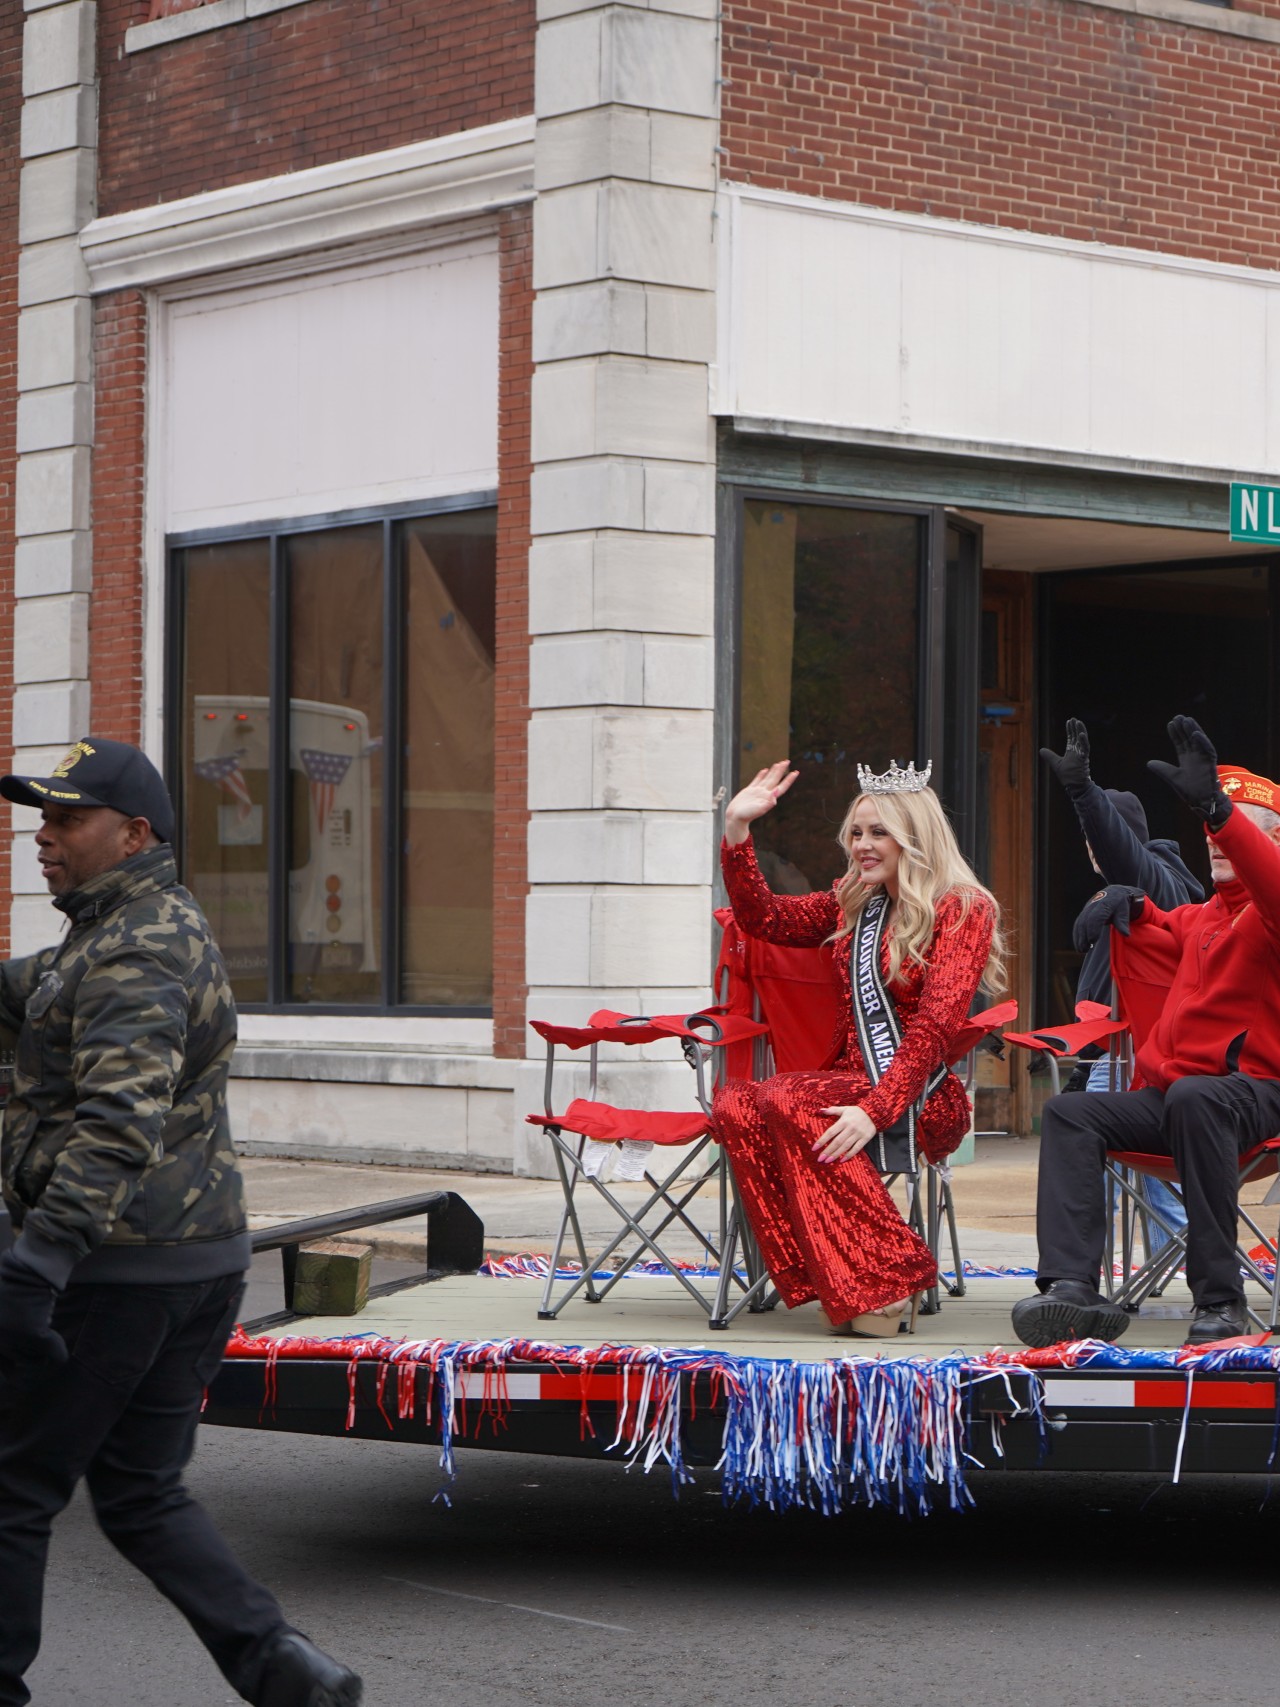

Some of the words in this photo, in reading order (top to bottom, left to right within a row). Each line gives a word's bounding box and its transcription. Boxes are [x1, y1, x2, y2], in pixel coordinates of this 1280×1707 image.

[1240, 488, 1259, 532] N
[1243, 791, 1274, 806] LEAGUE
[1245, 781, 1275, 795] MARINE
[1247, 787, 1273, 799] CORPS
[858, 919, 882, 1017] VOLUNTEER
[868, 1021, 895, 1073] AMER
